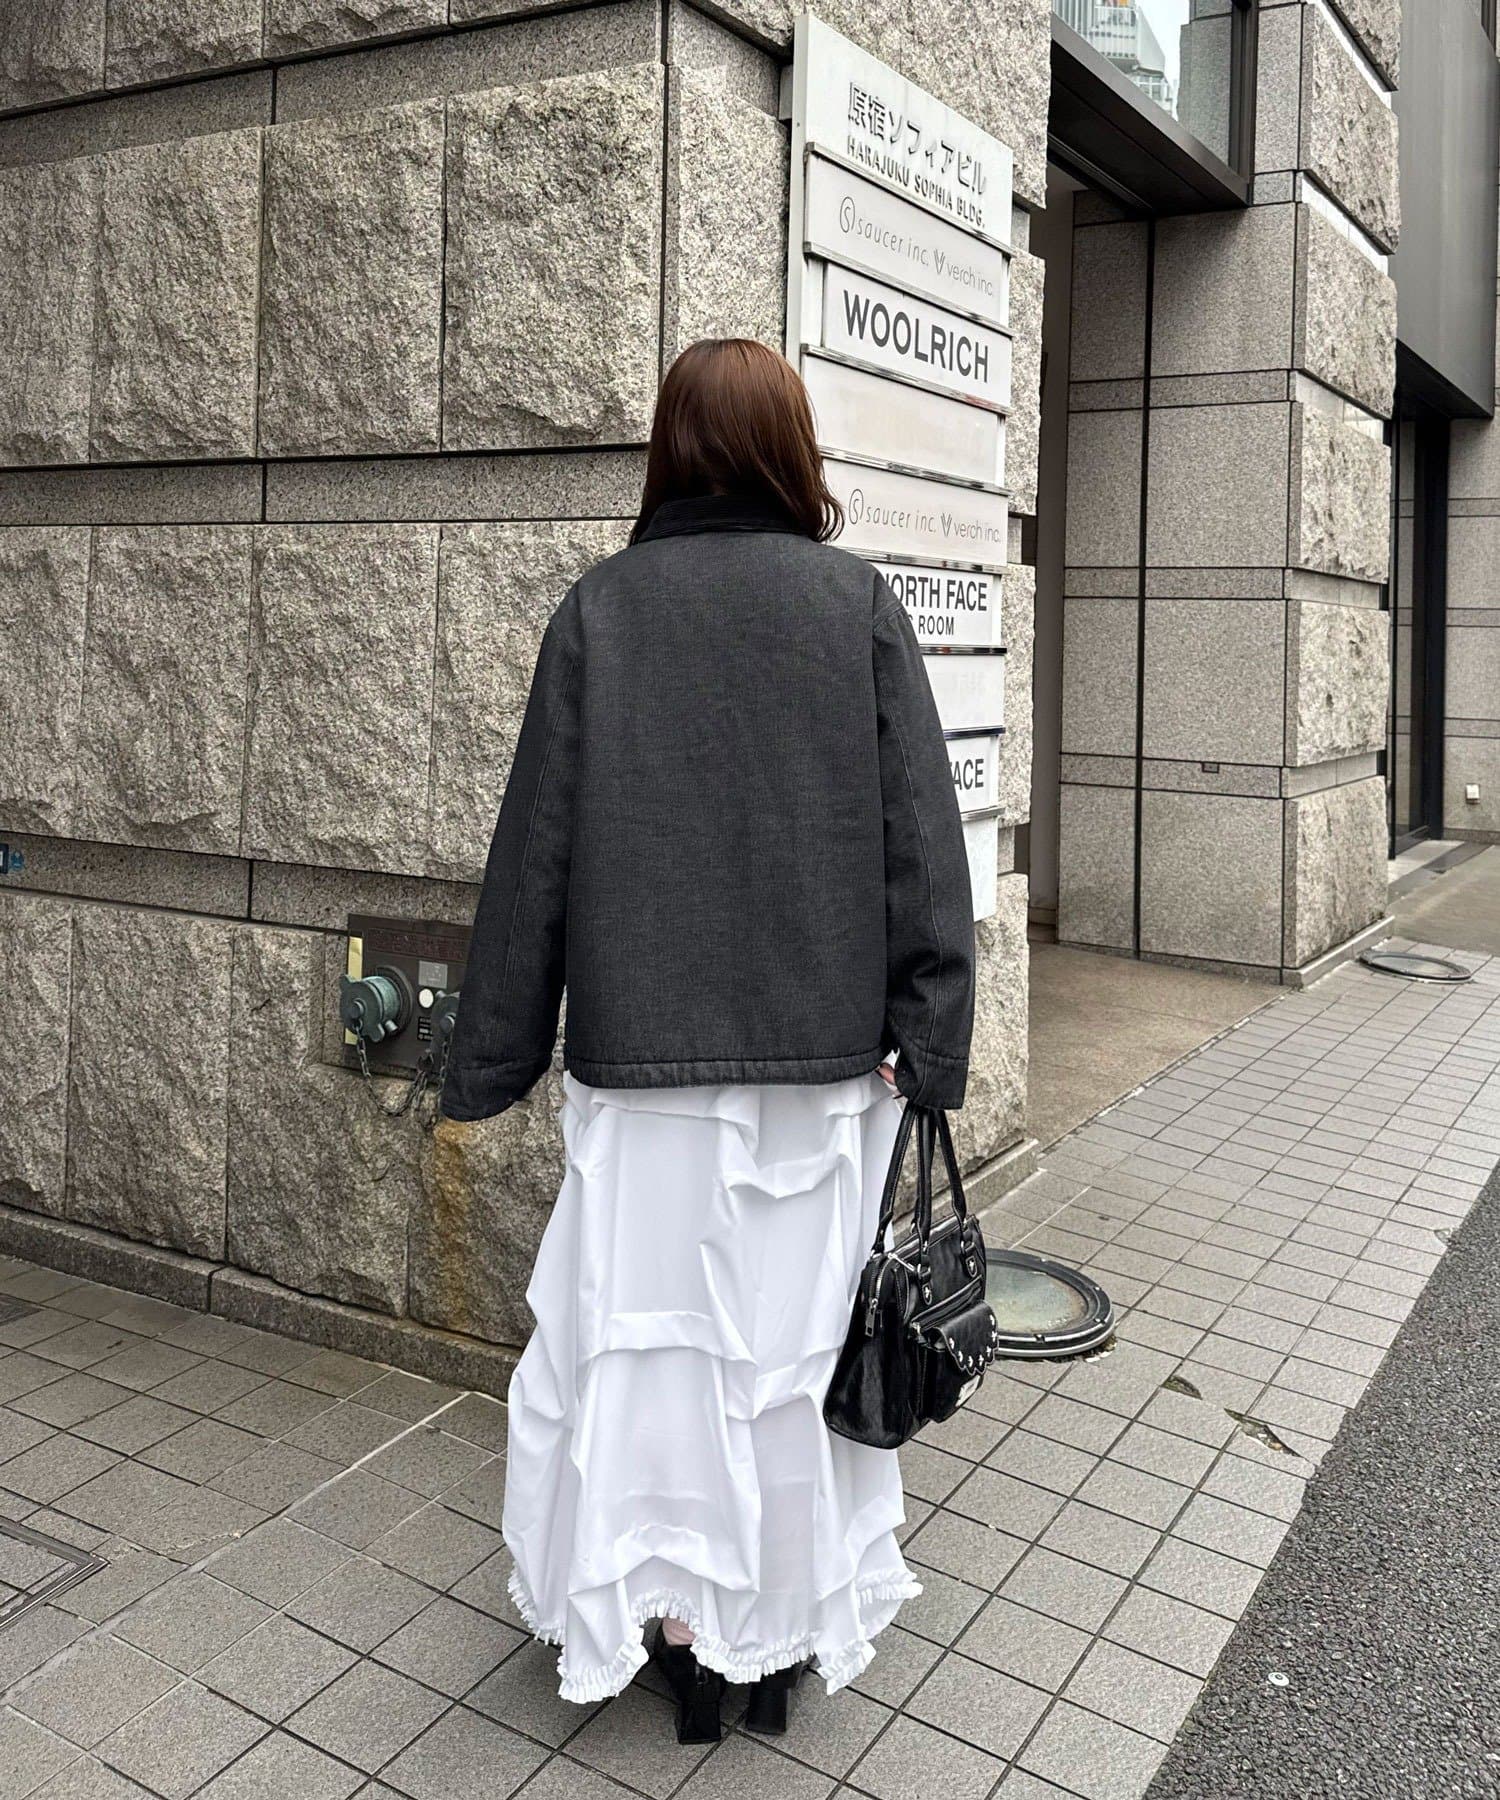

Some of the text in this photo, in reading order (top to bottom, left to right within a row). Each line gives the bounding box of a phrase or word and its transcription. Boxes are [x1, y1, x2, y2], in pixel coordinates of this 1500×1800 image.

[848, 81, 987, 196] 原宿ソフィアビル
[846, 135, 986, 228] HARAJUKU SOPHIA BLDG.
[856, 217, 903, 254] saucer
[947, 263, 976, 287] verch
[843, 289, 989, 383] WOOLRICH
[866, 505, 911, 529] saucer
[954, 520, 983, 540] verch
[886, 573, 988, 611] ORTH FACE
[918, 615, 955, 636] ROOM
[949, 758, 985, 790] ACE
